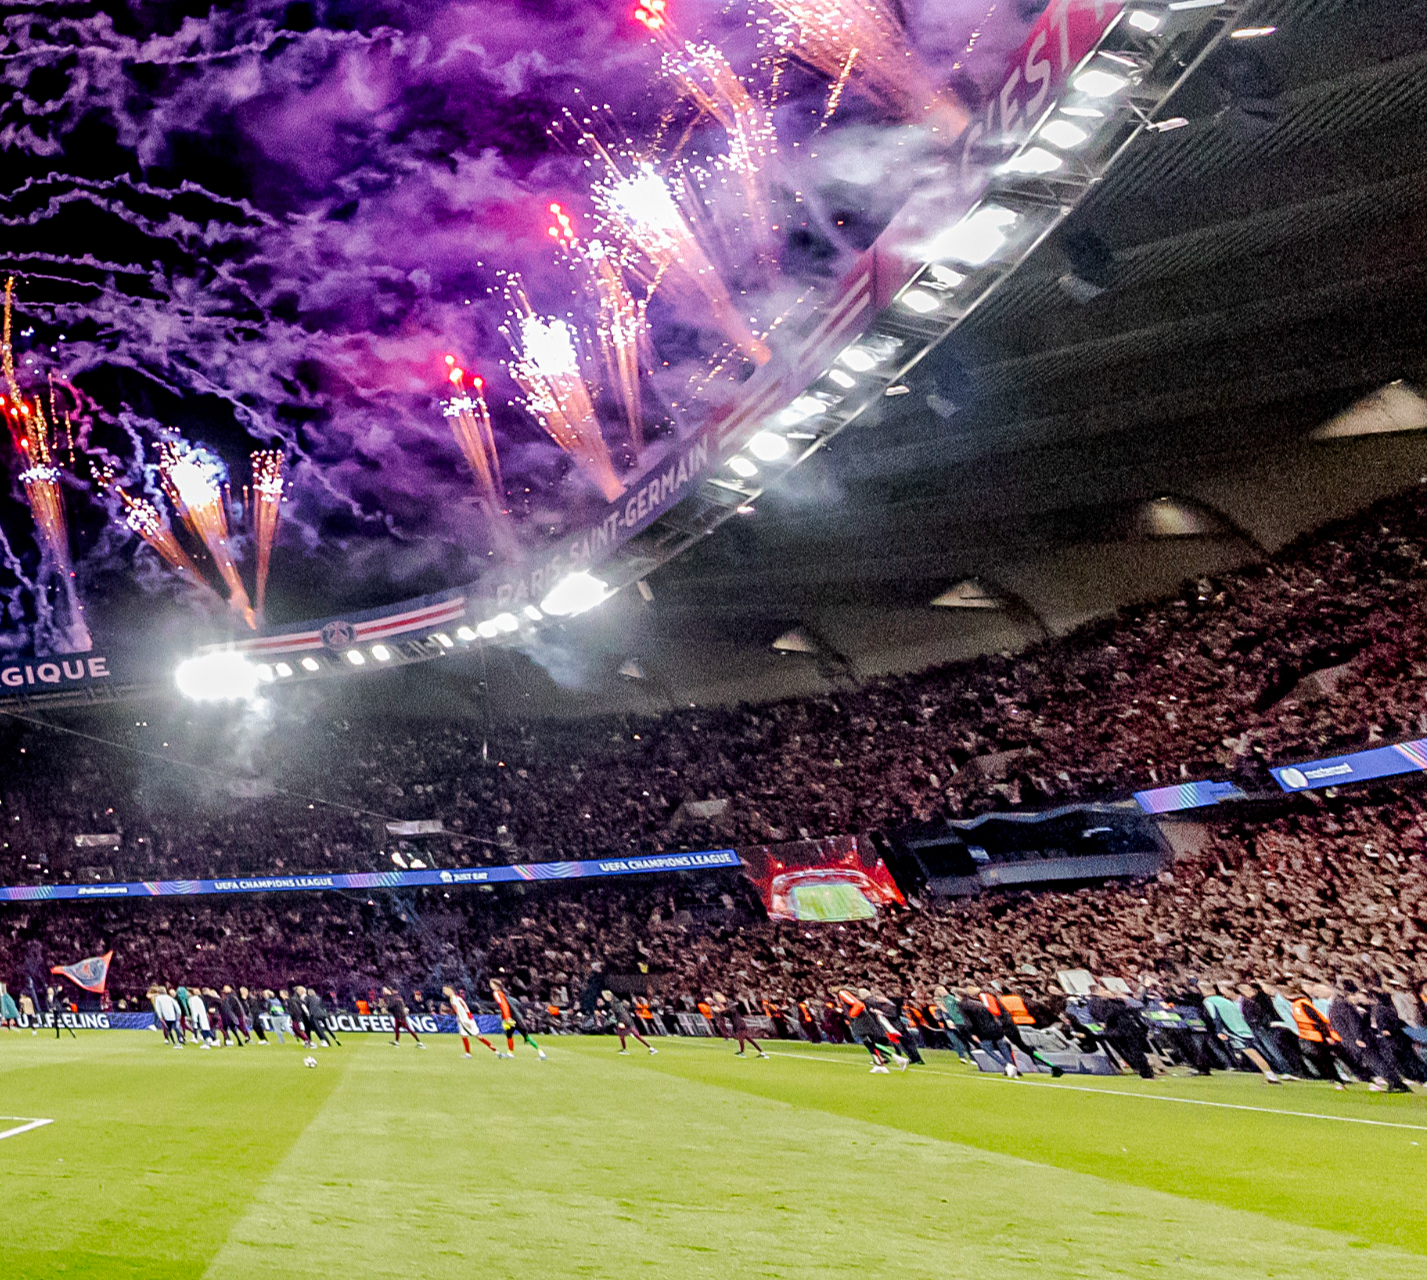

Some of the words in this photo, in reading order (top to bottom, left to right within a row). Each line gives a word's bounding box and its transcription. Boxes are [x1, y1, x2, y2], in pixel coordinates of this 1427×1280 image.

[598, 861, 629, 872] UEFA
[627, 857, 691, 870] CHAMPIONS
[690, 853, 733, 865] LEAGUE
[214, 881, 239, 890] UEFA
[239, 879, 295, 889] CHAMPIONS
[295, 877, 333, 887] LEAGUE
